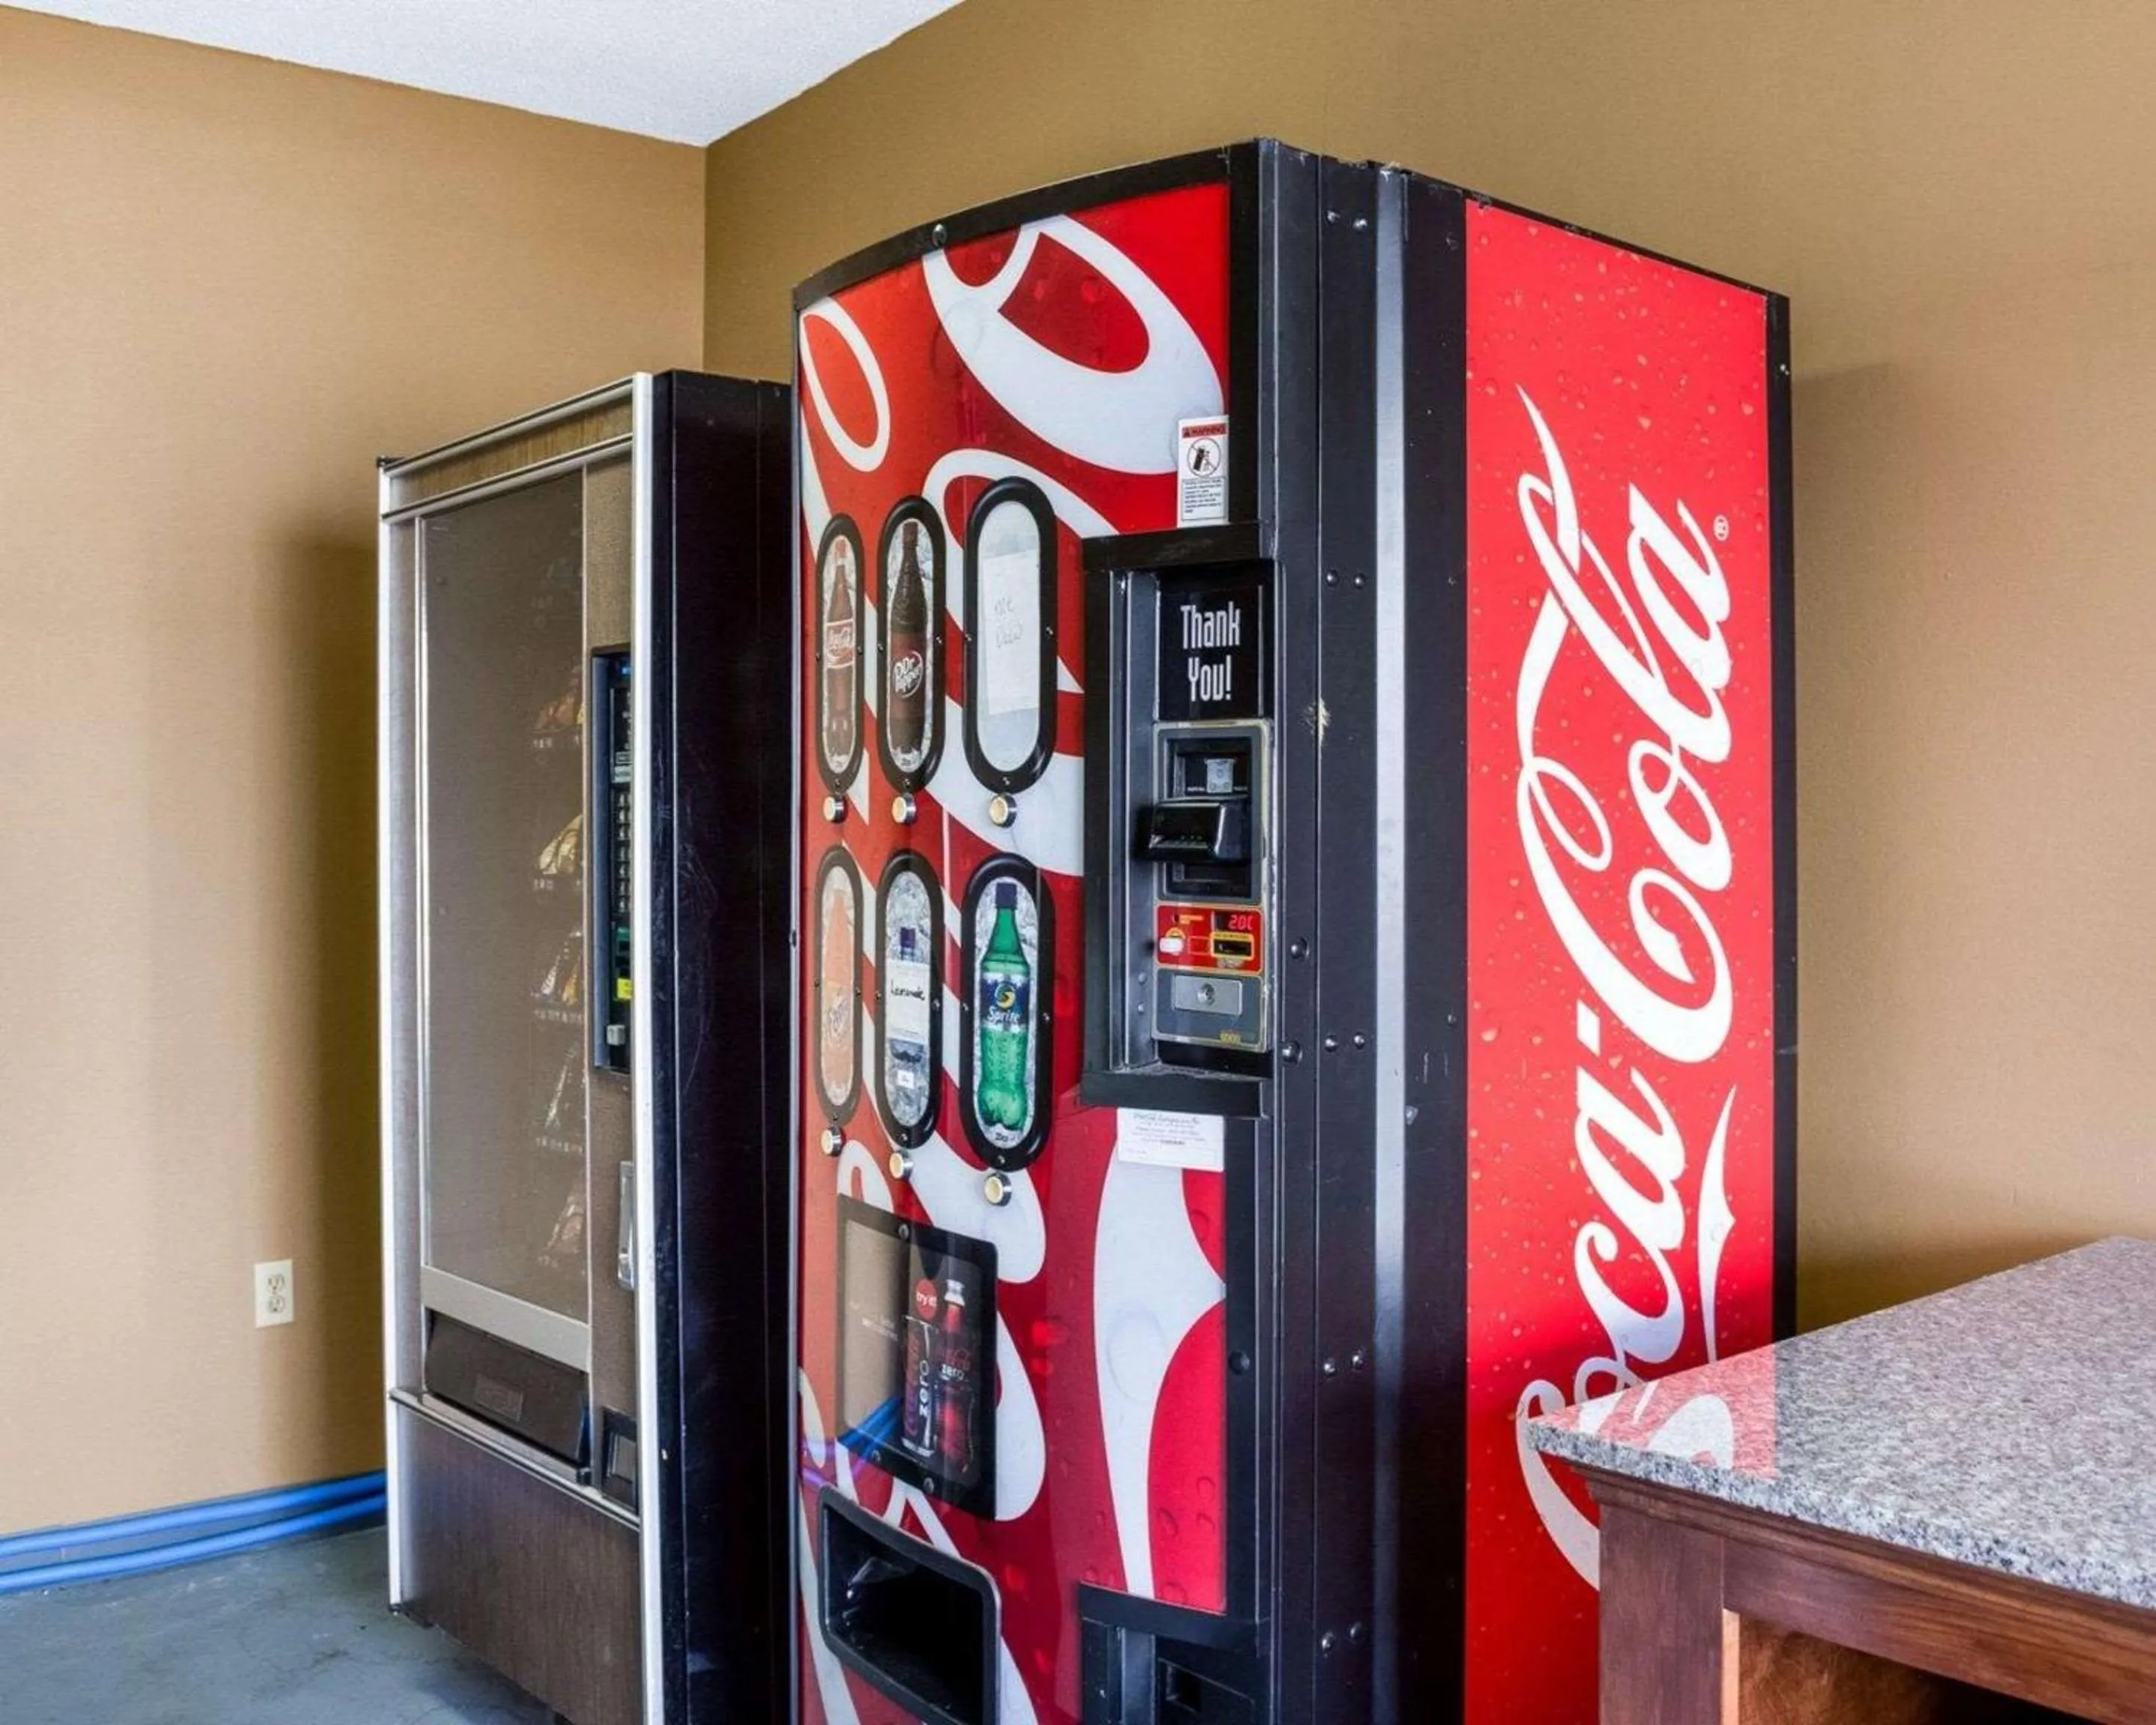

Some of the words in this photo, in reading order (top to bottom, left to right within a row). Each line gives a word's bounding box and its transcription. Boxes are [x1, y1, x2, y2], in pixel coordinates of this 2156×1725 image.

[1180, 601, 1240, 649] Thank
[1188, 654, 1231, 702] You!
[942, 1363, 964, 1381] zero
